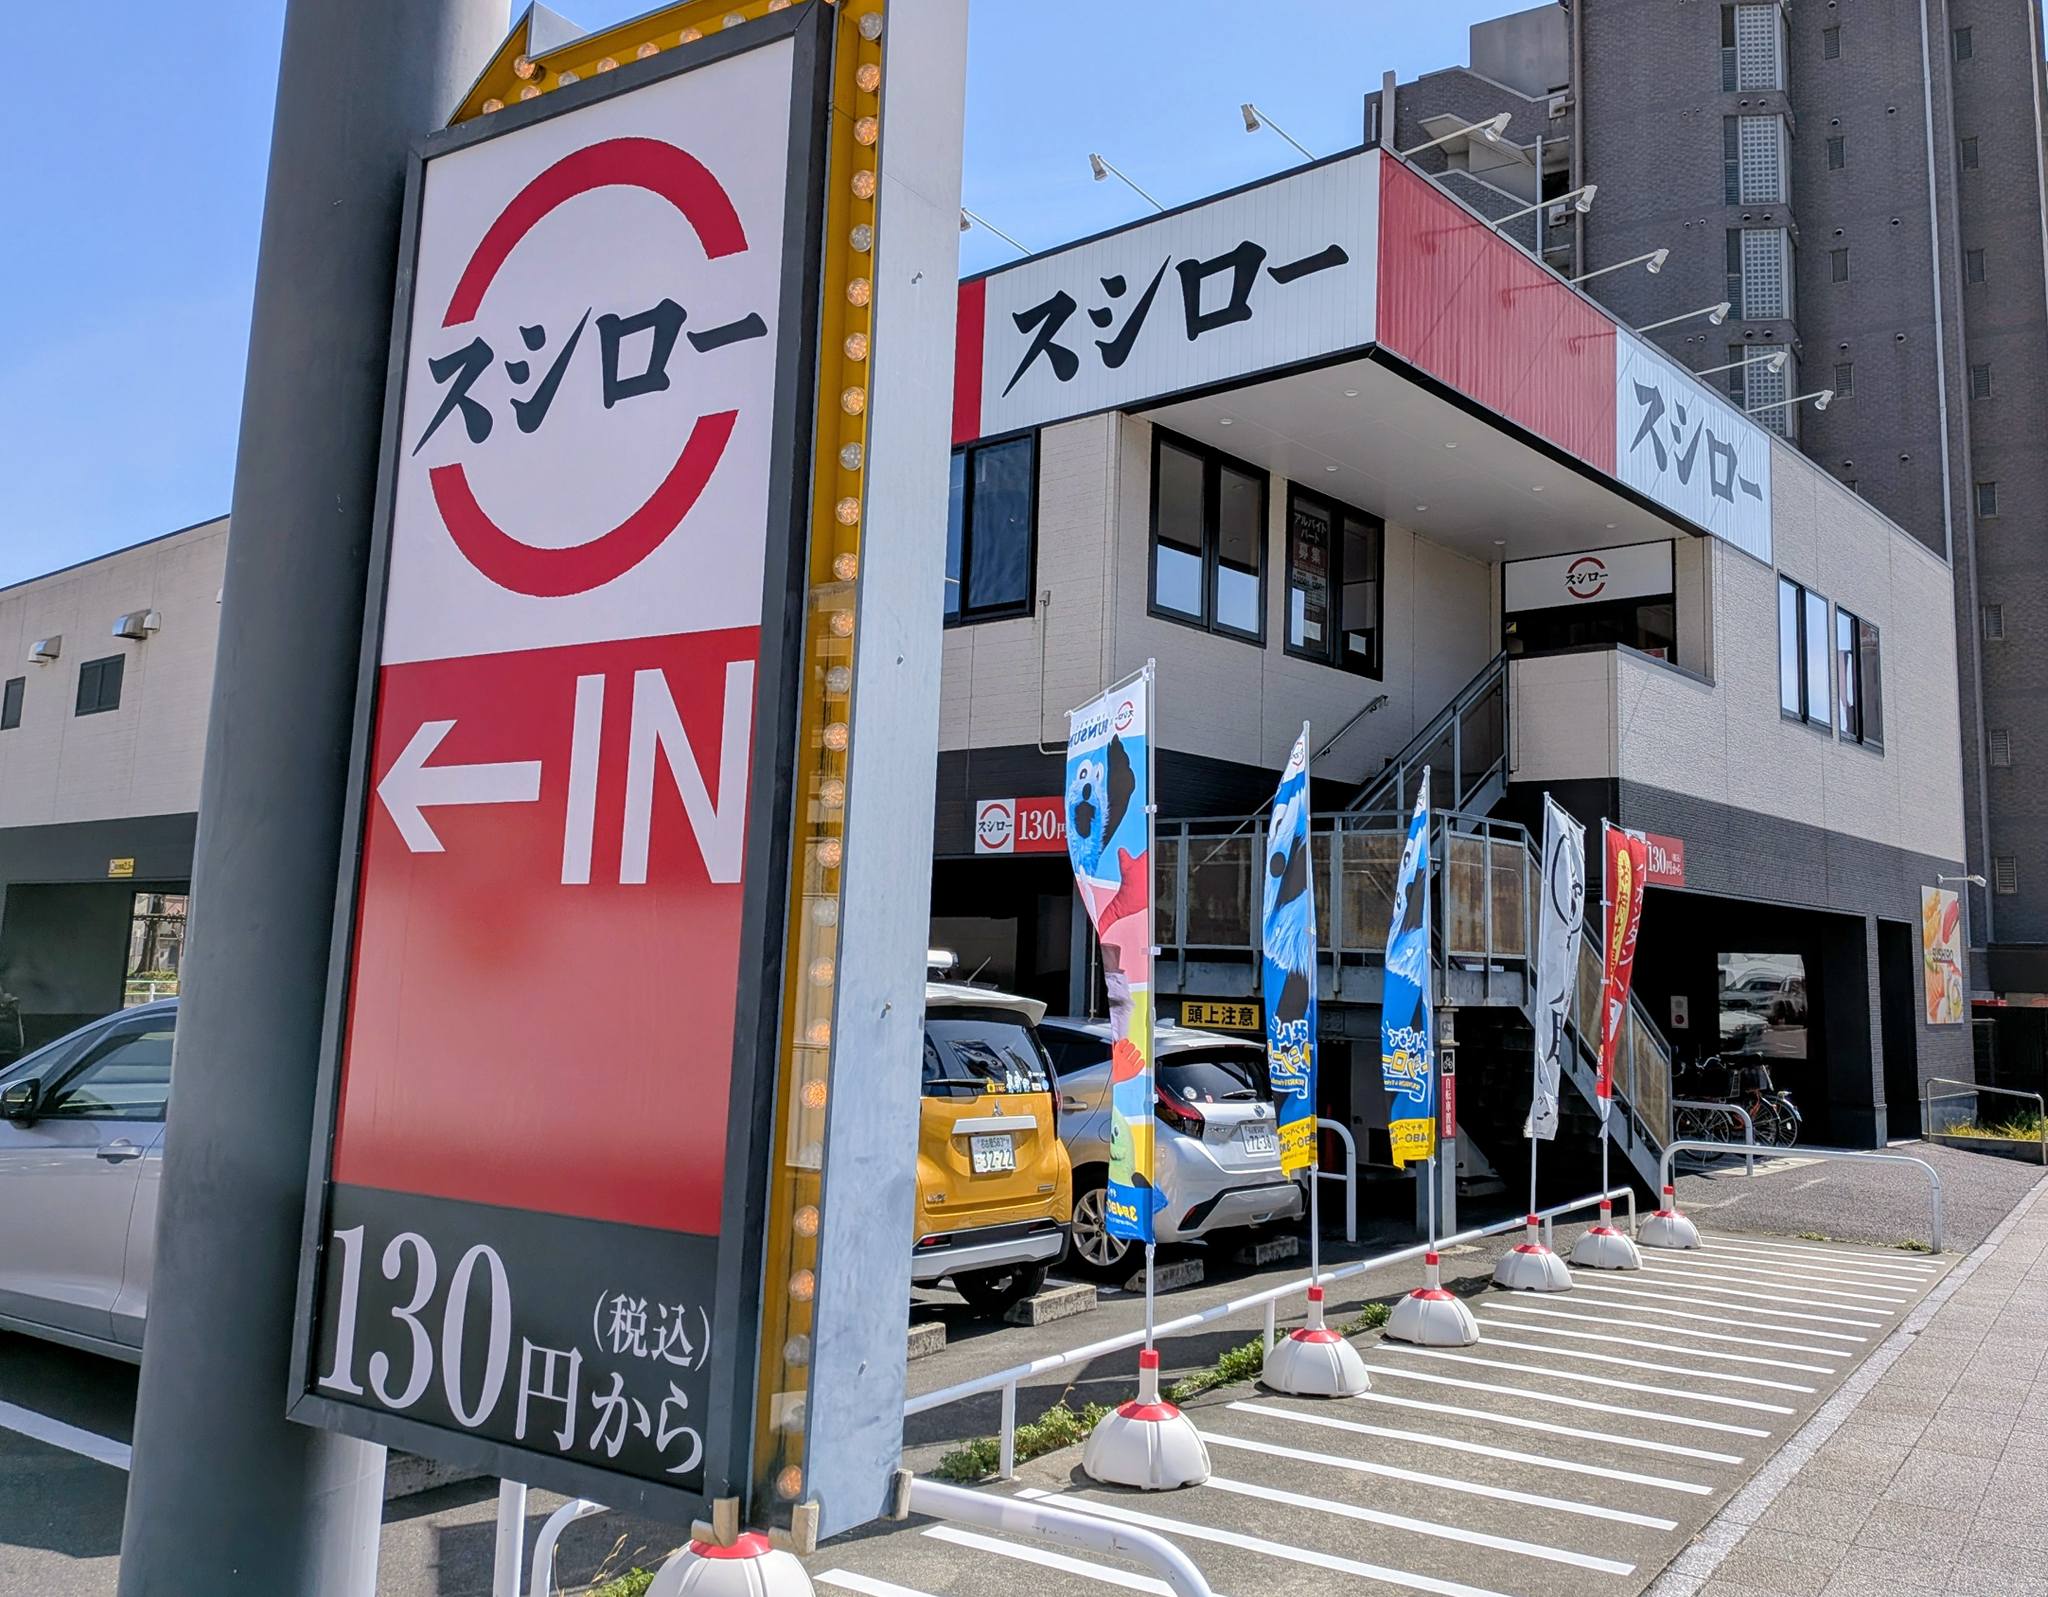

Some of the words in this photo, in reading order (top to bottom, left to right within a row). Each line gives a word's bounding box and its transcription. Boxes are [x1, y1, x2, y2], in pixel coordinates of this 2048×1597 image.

[413, 298, 768, 457] スシロー
[1002, 240, 1349, 398] スシロー
[1629, 376, 1763, 503] スシロー
[1564, 571, 1609, 586] スシロー
[561, 660, 756, 884] IN
[977, 820, 1013, 832] スシロー
[1187, 1005, 1254, 1027] 頭上注意
[318, 1224, 702, 1475] 130円から
[593, 1288, 710, 1372] (税込)
